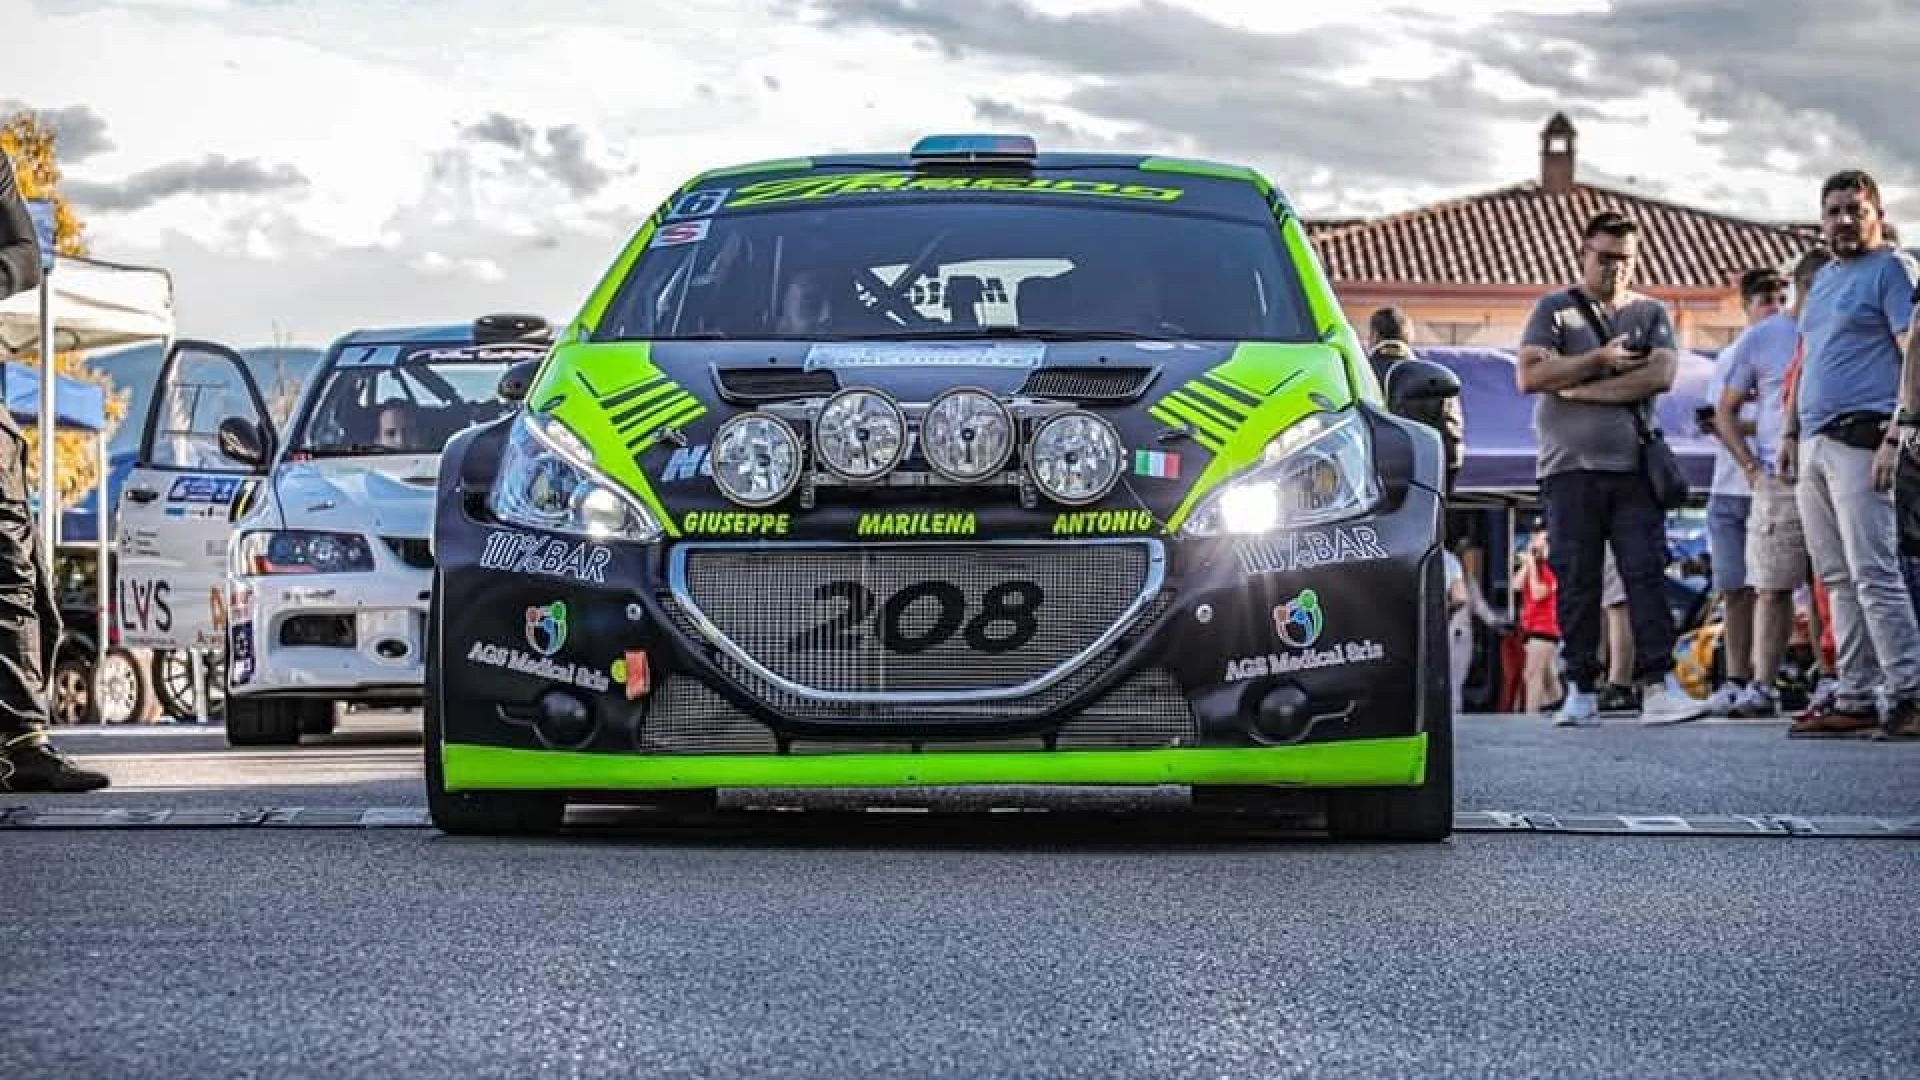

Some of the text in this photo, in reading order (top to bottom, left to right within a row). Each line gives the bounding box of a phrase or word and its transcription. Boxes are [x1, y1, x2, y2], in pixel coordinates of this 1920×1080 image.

[683, 511, 791, 534] GIUSEPPE
[857, 511, 976, 536] MARILENA
[1052, 509, 1153, 534] ANTONIO
[119, 578, 172, 633] LVS
[787, 579, 1045, 654] 208
[507, 649, 576, 683] Medical
[1224, 658, 1269, 682] AGS
[1268, 643, 1346, 674] Medical
